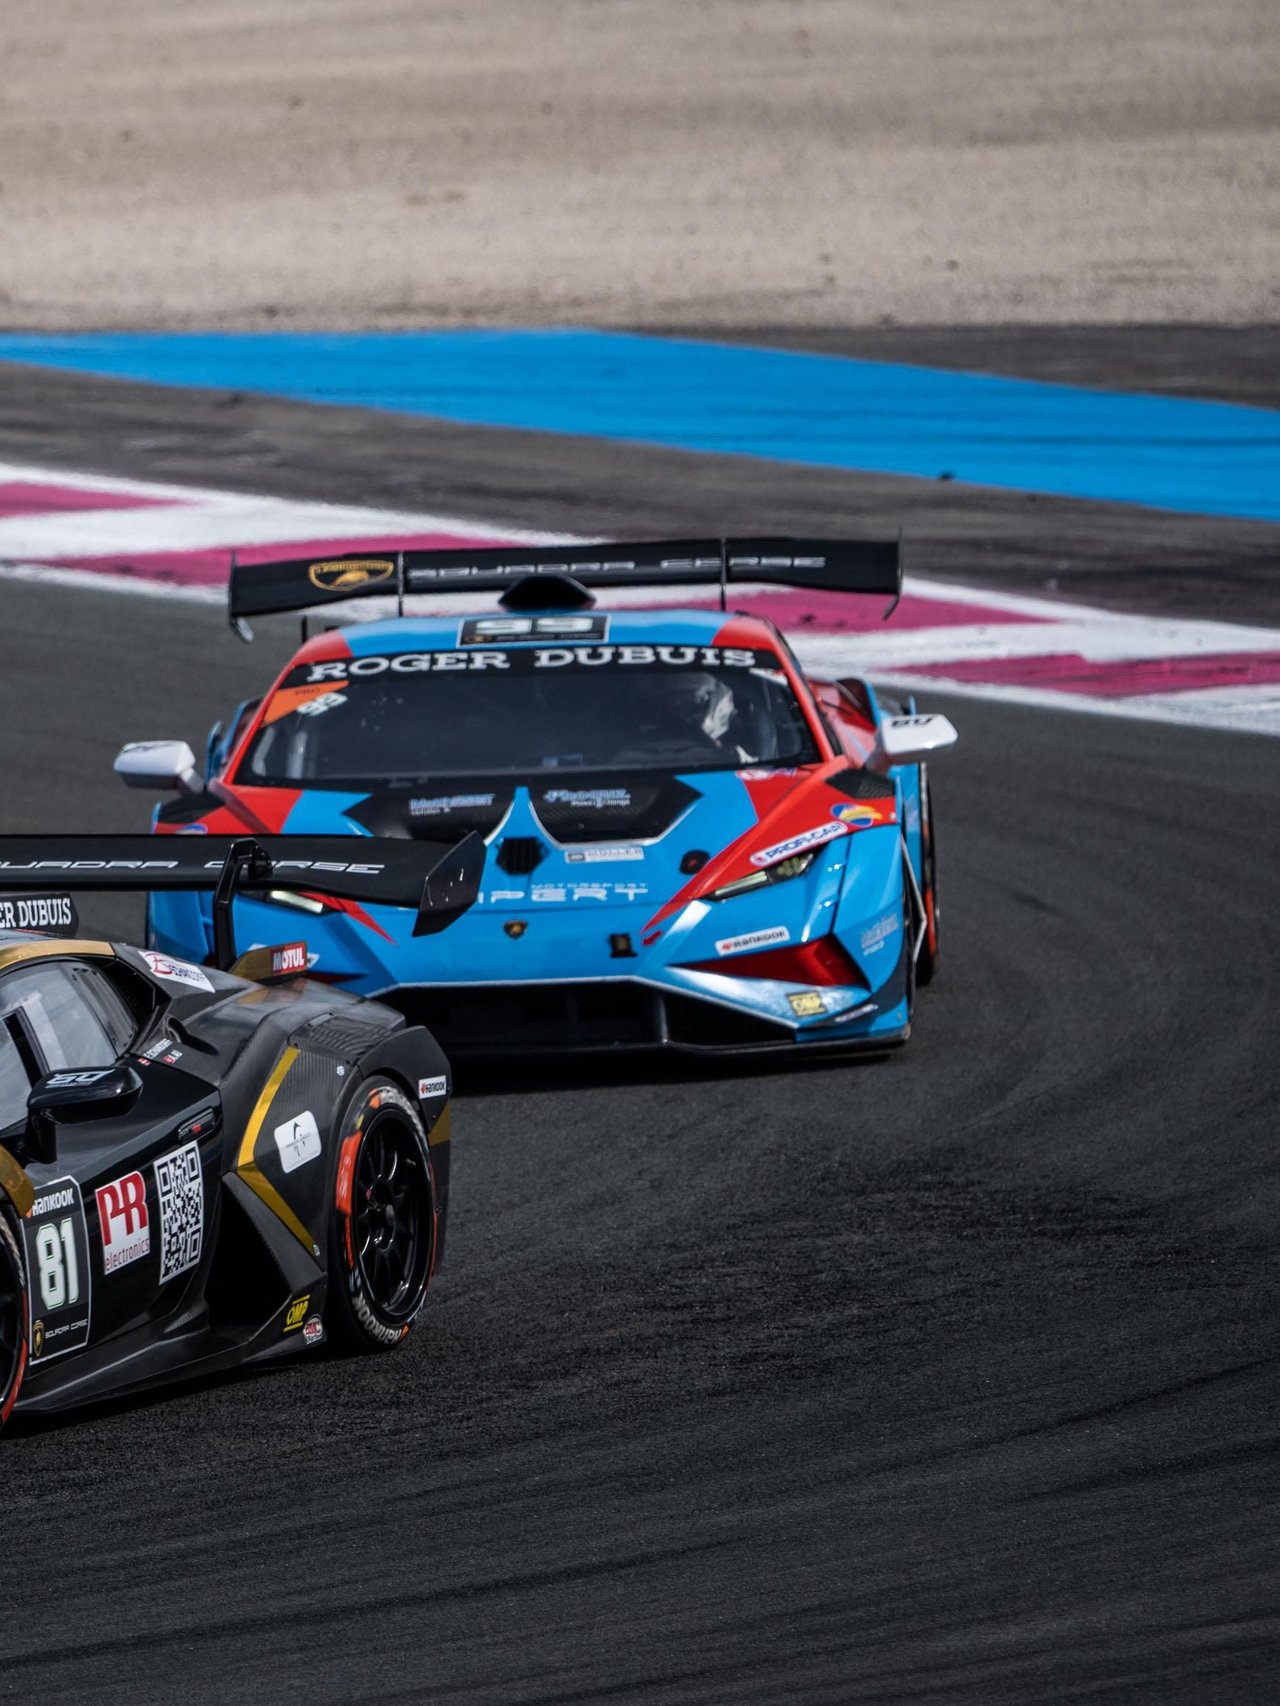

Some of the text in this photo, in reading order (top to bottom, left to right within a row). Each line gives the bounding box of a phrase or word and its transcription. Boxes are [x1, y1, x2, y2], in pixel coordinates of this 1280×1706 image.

[306, 645, 756, 682] ROGER DUBUIS
[17, 897, 72, 928] DUBUIS
[272, 946, 306, 972] MOTUL
[96, 1172, 149, 1247] PR
[36, 1217, 80, 1310] 81
[104, 1237, 150, 1272] electronics
[286, 1301, 308, 1325] OMP
